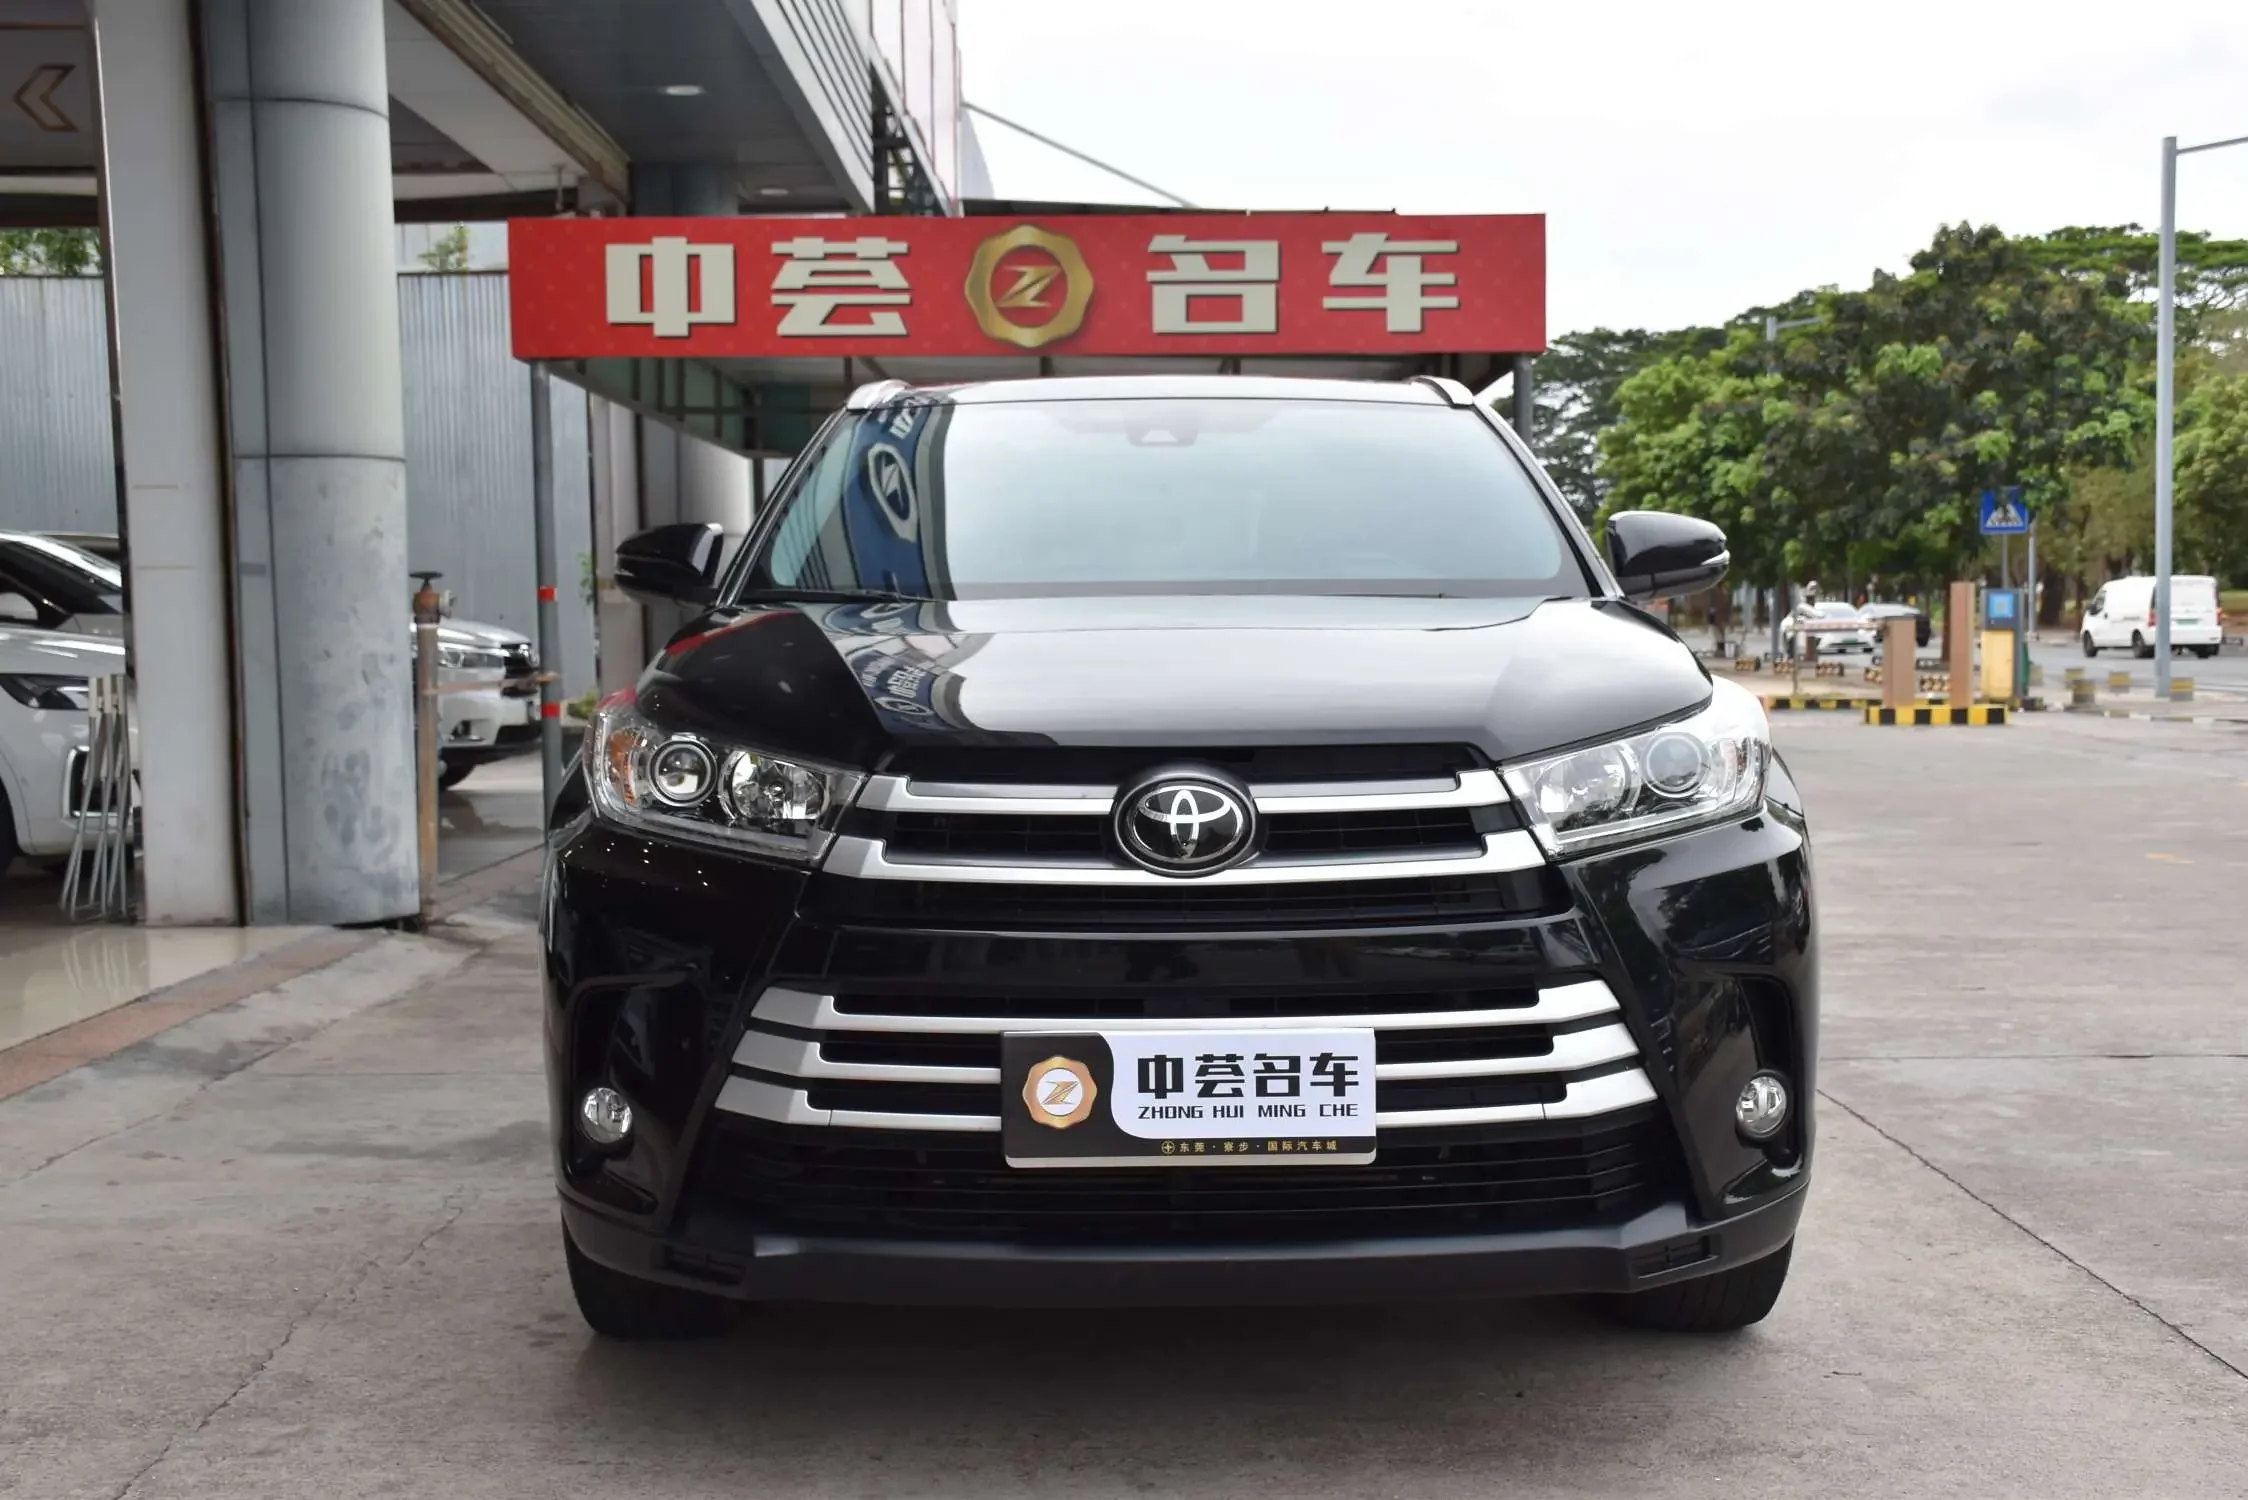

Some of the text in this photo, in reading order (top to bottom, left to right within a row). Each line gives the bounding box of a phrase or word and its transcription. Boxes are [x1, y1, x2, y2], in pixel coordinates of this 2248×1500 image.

[1146, 233, 1460, 333] 名车
[1137, 1052, 1359, 1100] 中荟名车
[1138, 1103, 1359, 1119] ZHONG HUI MING CHE
